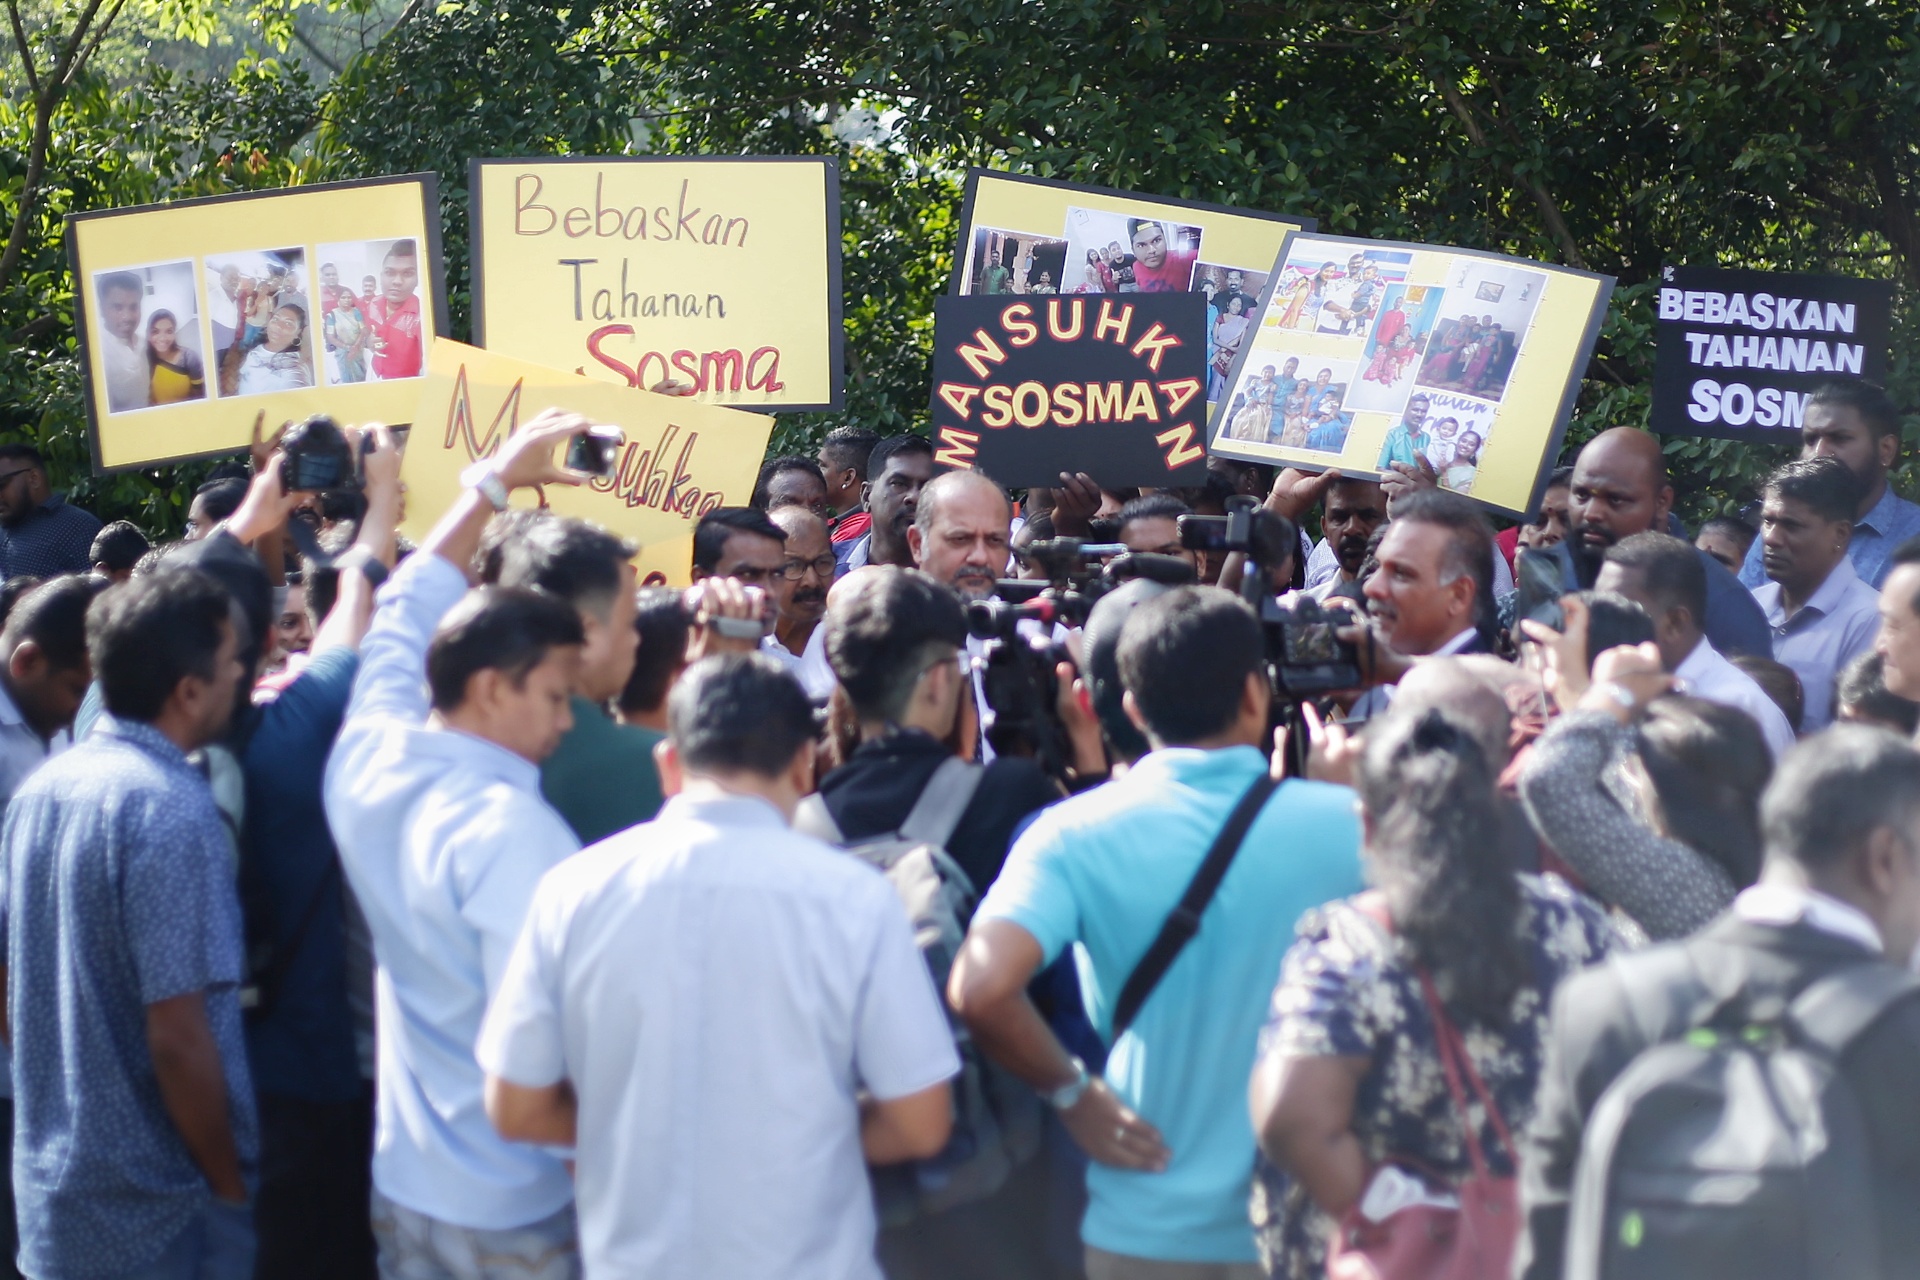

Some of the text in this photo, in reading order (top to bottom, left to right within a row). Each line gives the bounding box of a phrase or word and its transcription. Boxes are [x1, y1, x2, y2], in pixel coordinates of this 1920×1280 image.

[514, 171, 750, 248] Bebaskan
[558, 257, 727, 321] Tahanan
[1659, 287, 1856, 332] BEBASKAN
[575, 323, 787, 397] Sosma
[1685, 331, 1865, 375] TAHANAN
[934, 298, 1204, 471] MANSUHKAN
[979, 378, 1161, 429] SOSMA
[1687, 379, 1812, 428] SOSM
